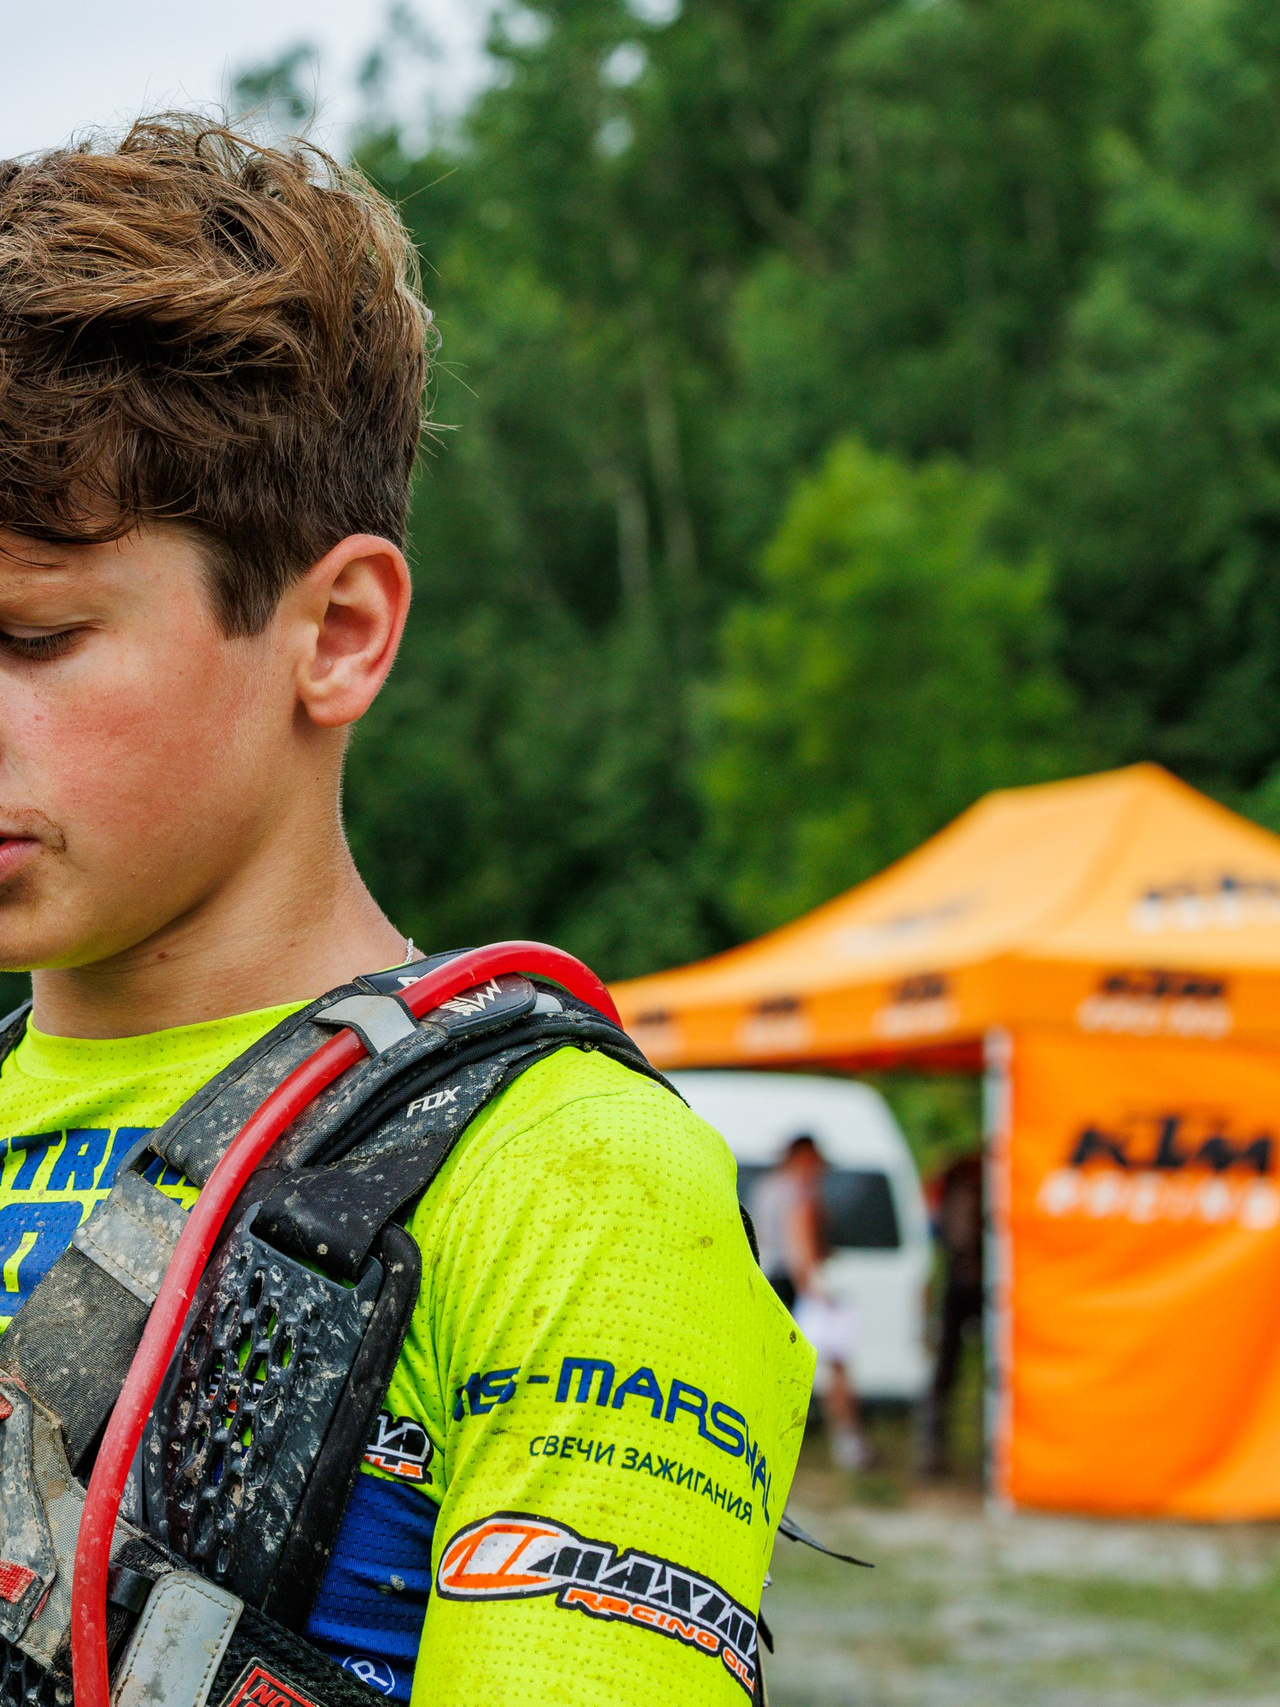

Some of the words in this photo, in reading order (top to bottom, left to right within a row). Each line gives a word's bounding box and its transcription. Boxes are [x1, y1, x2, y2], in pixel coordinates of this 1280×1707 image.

[406, 1085, 462, 1119] FOX
[529, 1434, 616, 1466] СВЕЧИ
[621, 1447, 753, 1526] ЗАЖИГАНИЯ
[566, 1588, 719, 1650] RACING
[722, 1646, 756, 1693] OIL
